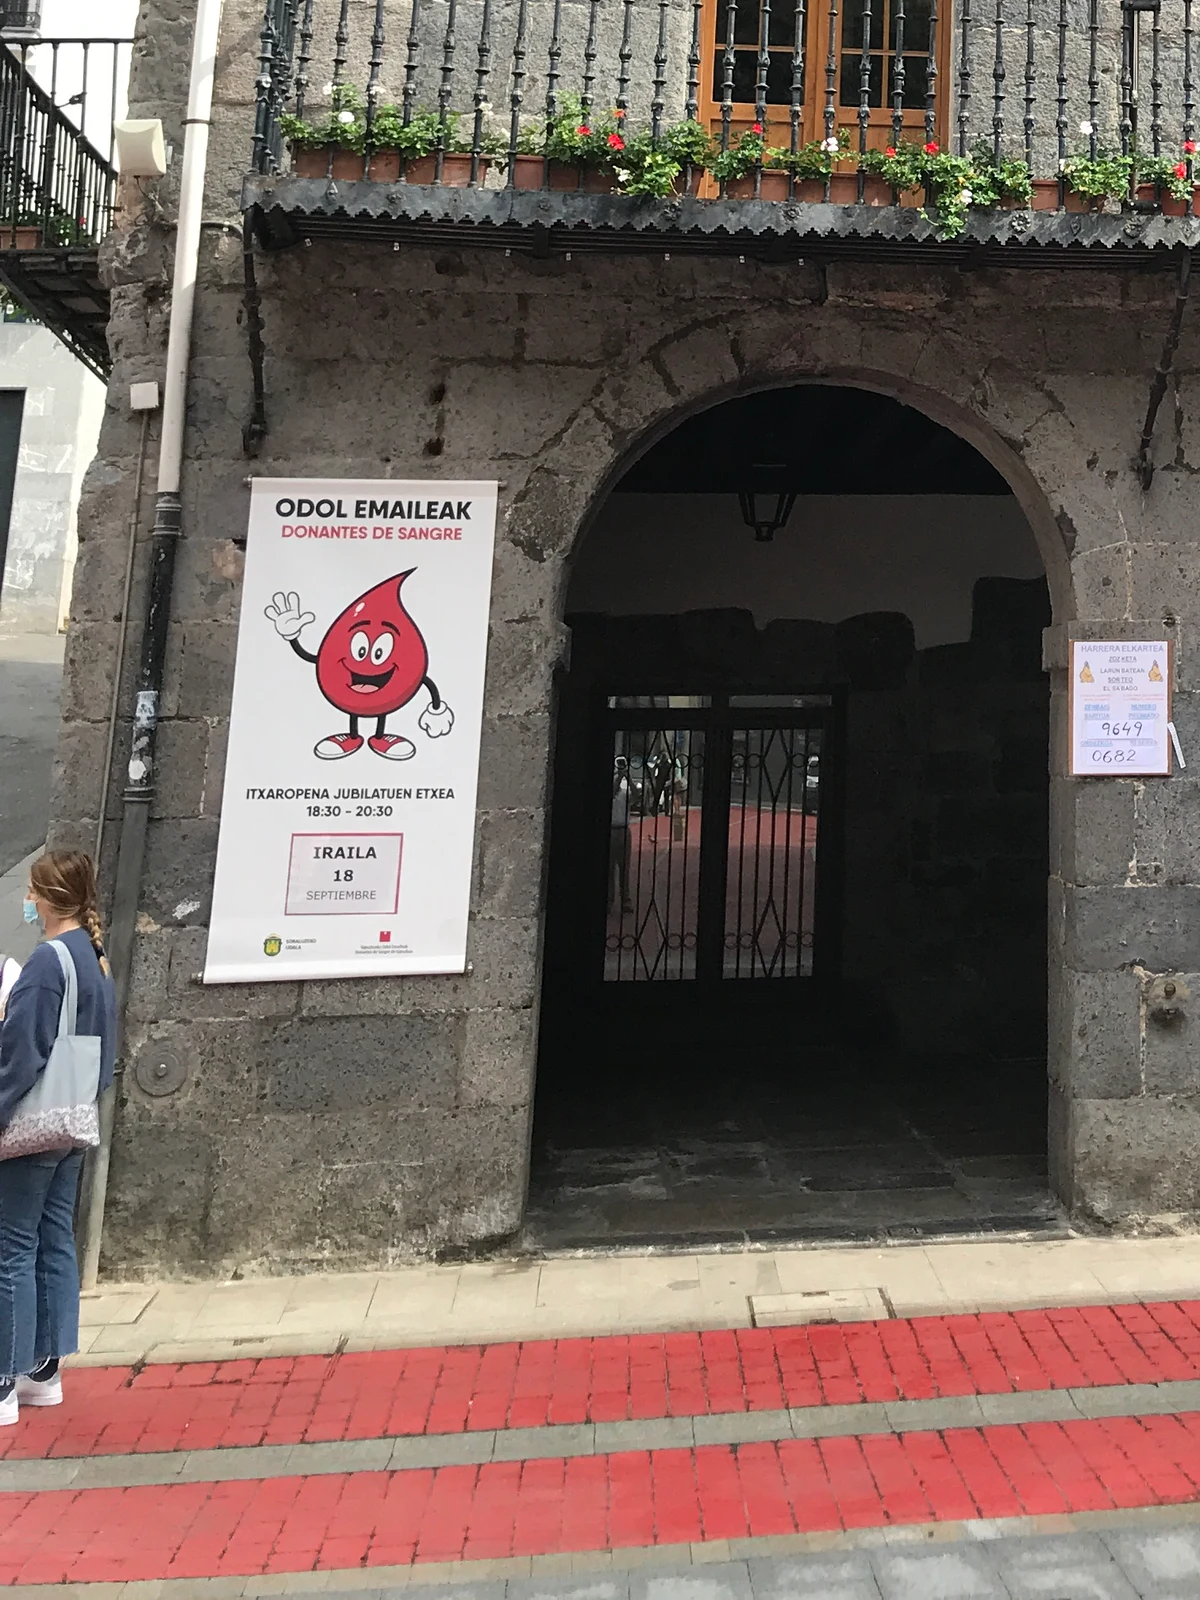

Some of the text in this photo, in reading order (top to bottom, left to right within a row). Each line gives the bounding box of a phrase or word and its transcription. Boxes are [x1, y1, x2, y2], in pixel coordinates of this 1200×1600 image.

[275, 497, 473, 520] ODOL EMAILEAK
[281, 525, 463, 541] DONANTES DE SANGRE
[1101, 721, 1143, 737] 9649
[1091, 749, 1137, 764] 0682
[245, 787, 455, 800] ITXAROPENA JUBILATUEN ETXEA
[306, 805, 342, 817] 18:30
[355, 805, 393, 817] 20:30
[312, 846, 377, 859] IRAILA
[333, 869, 354, 882] 18
[306, 890, 377, 901] SEPTIEMBRE
